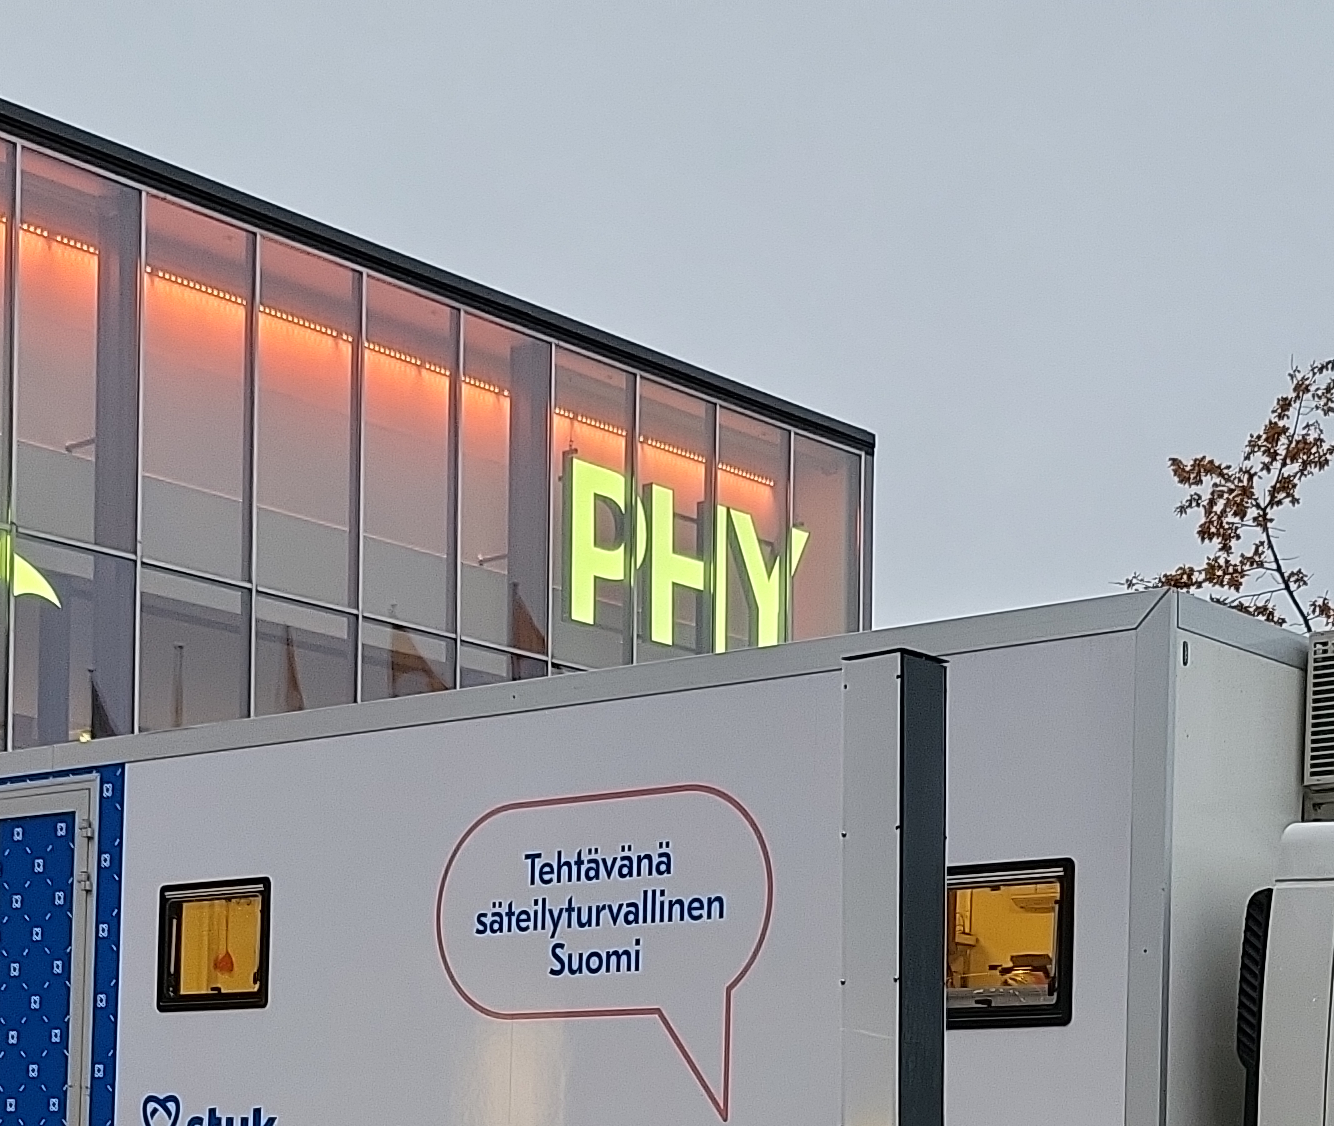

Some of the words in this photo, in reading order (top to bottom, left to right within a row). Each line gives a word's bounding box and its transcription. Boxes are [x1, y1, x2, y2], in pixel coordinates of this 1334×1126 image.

[571, 457, 811, 654] PHY
[524, 841, 673, 887] Tehtävänä
[474, 889, 726, 938] säteilyturvallinen
[548, 939, 642, 977] Suomi
